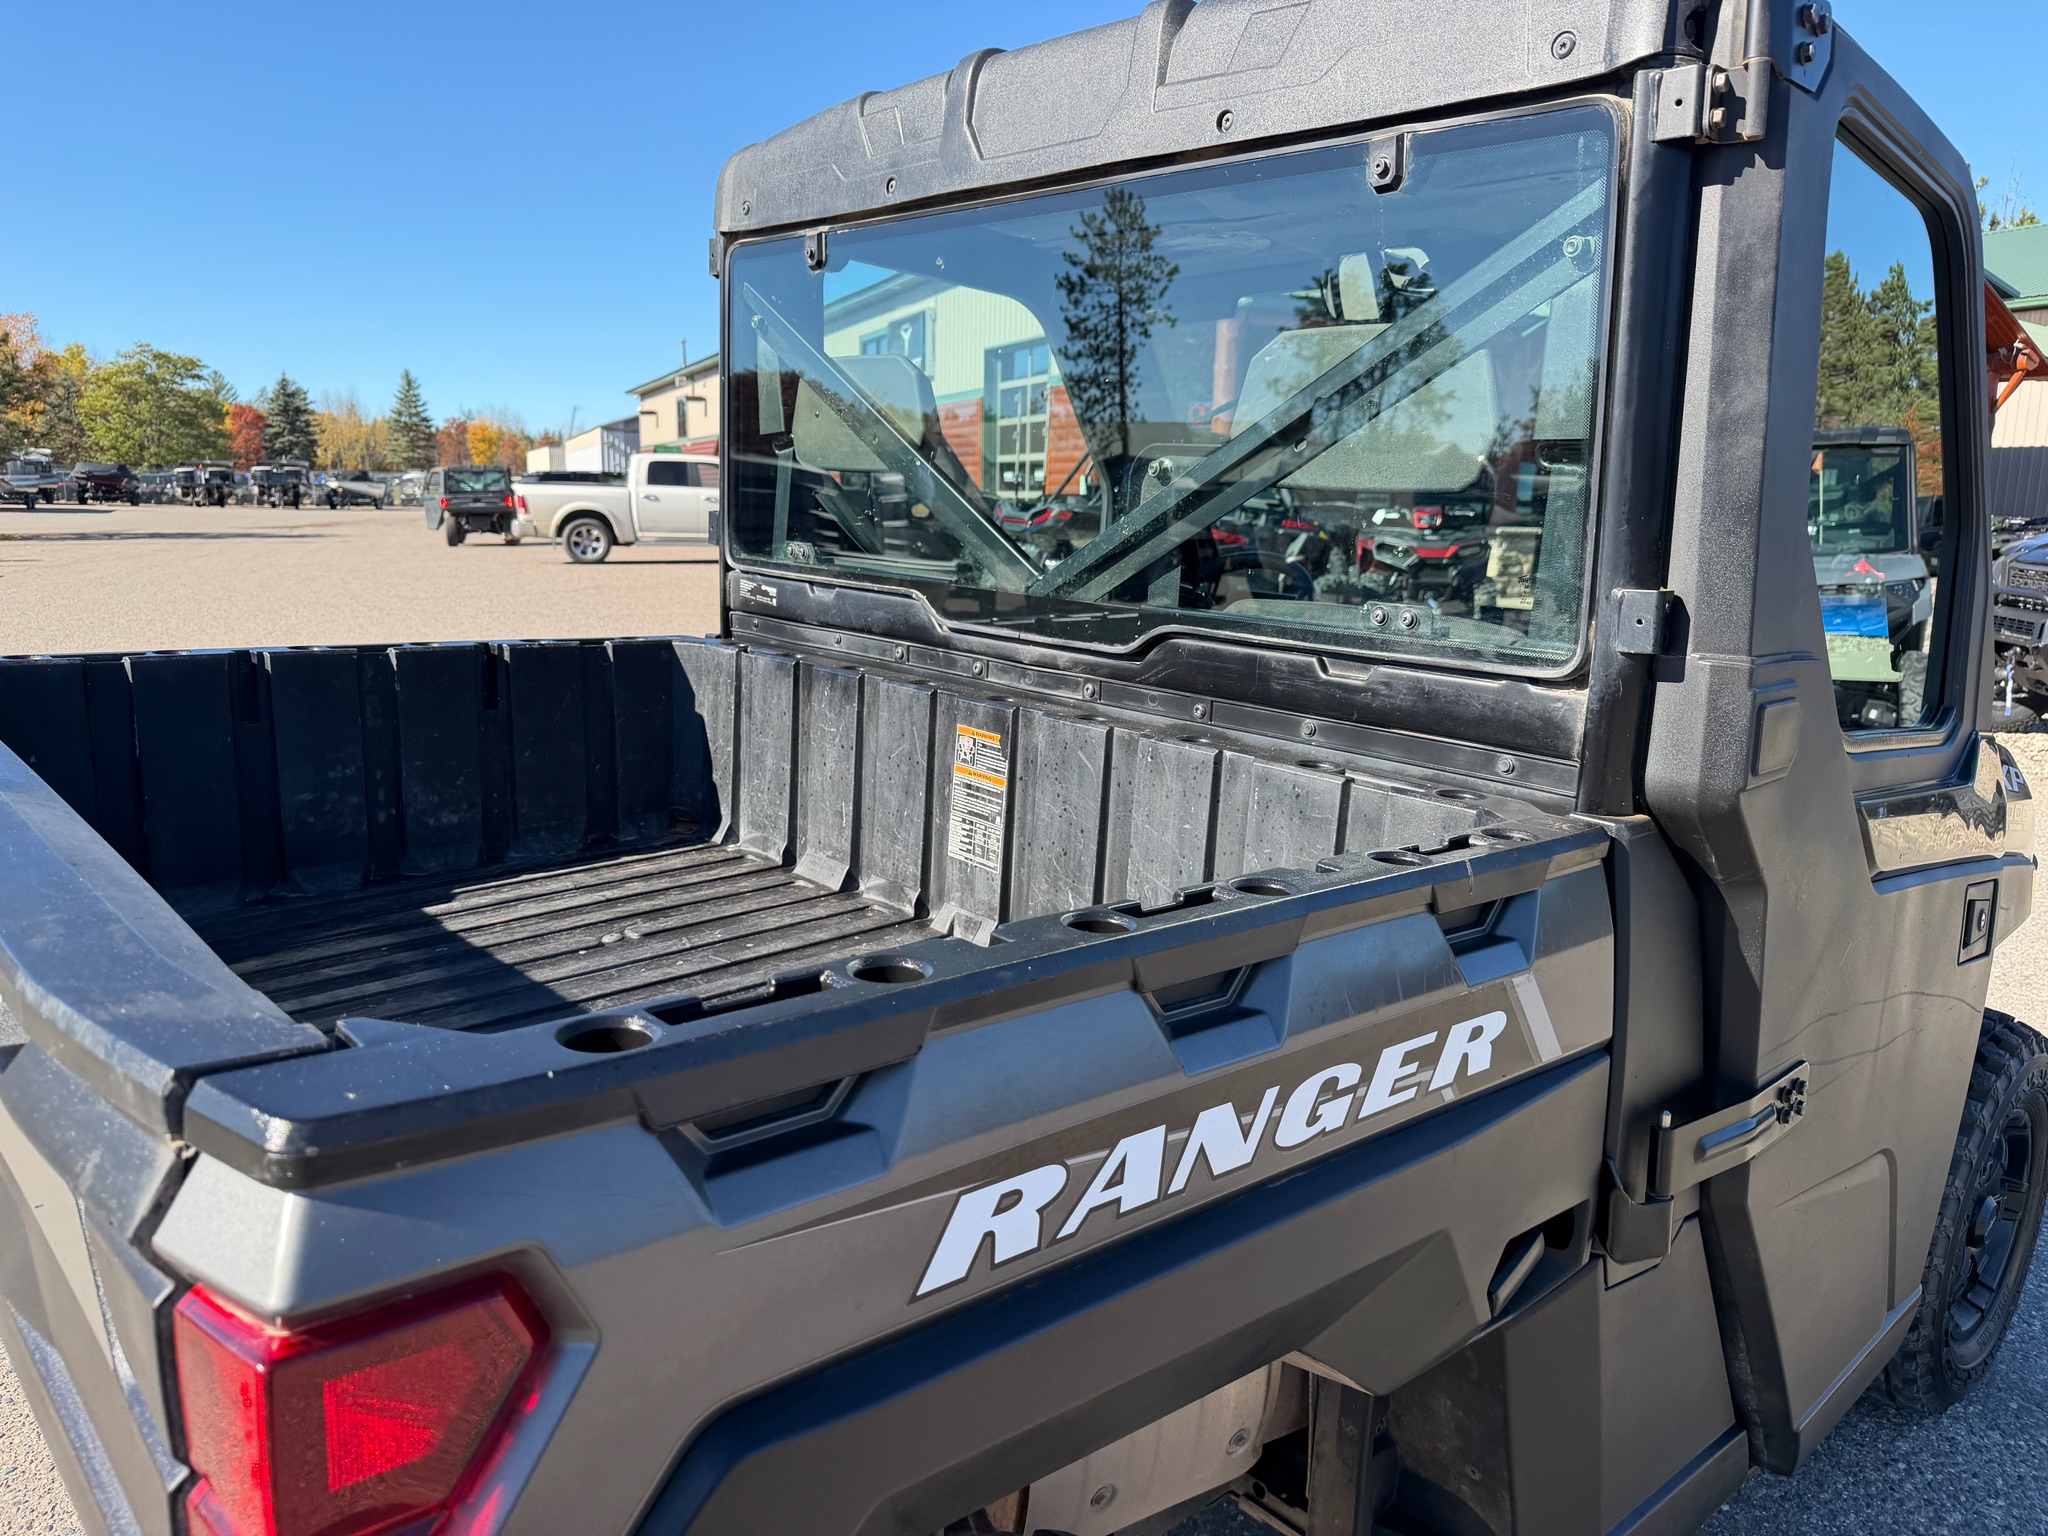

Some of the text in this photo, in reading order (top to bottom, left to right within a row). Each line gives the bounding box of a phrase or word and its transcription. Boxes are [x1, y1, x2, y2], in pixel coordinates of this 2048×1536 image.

[975, 729, 995, 742] WARNING
[971, 769, 992, 782] WARNING
[915, 1010, 1507, 1298] RANGER
